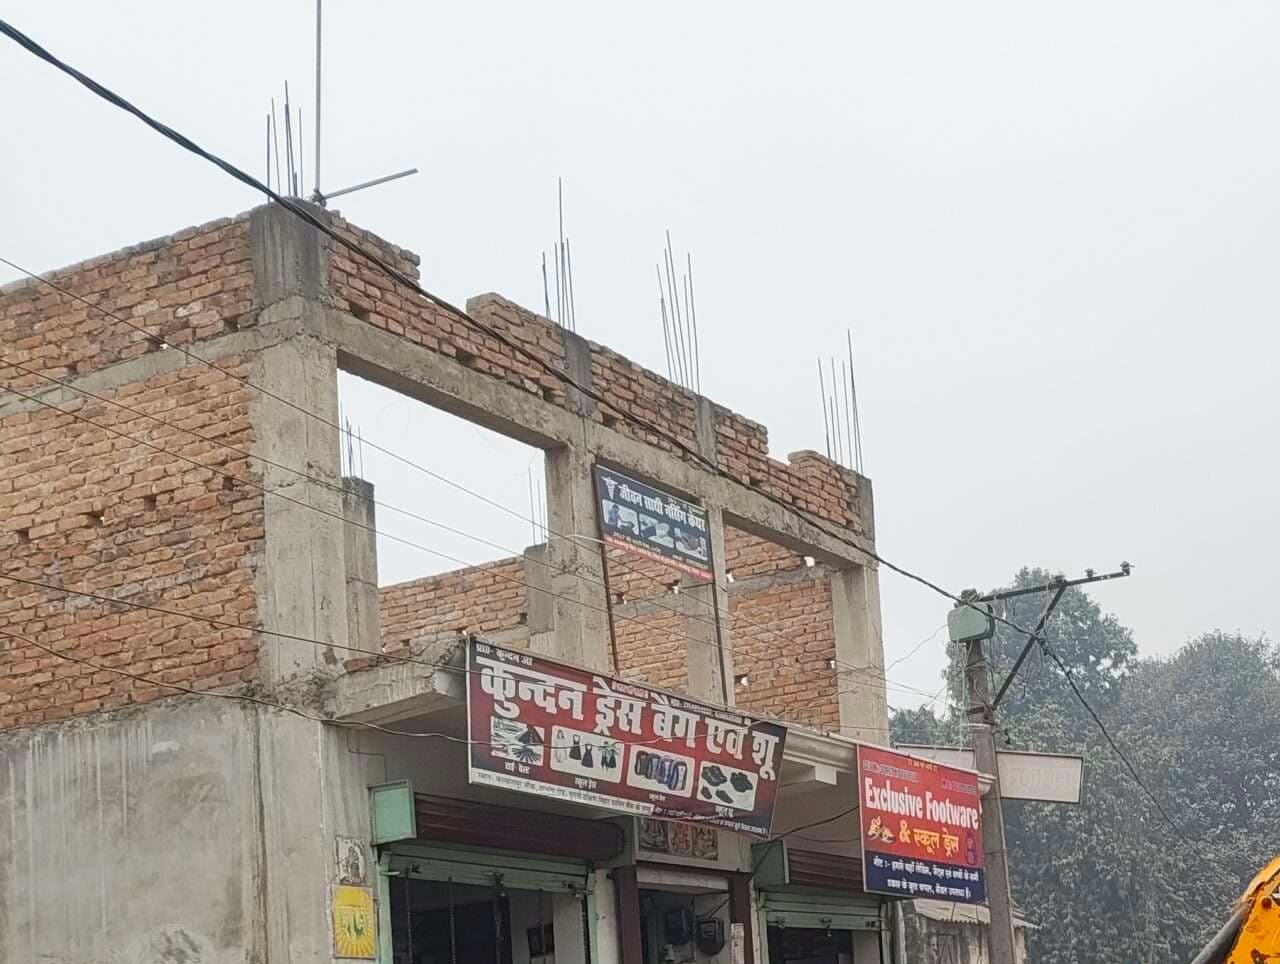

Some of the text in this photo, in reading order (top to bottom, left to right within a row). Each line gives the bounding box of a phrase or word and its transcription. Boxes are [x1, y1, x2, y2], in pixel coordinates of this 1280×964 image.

[476, 655, 588, 720] कुन्दन
[592, 675, 647, 736] ड्रेस
[751, 729, 780, 781] शू
[865, 776, 979, 830] Exclusive Footware
[899, 820, 960, 857] & स्कूल ड्रेस
